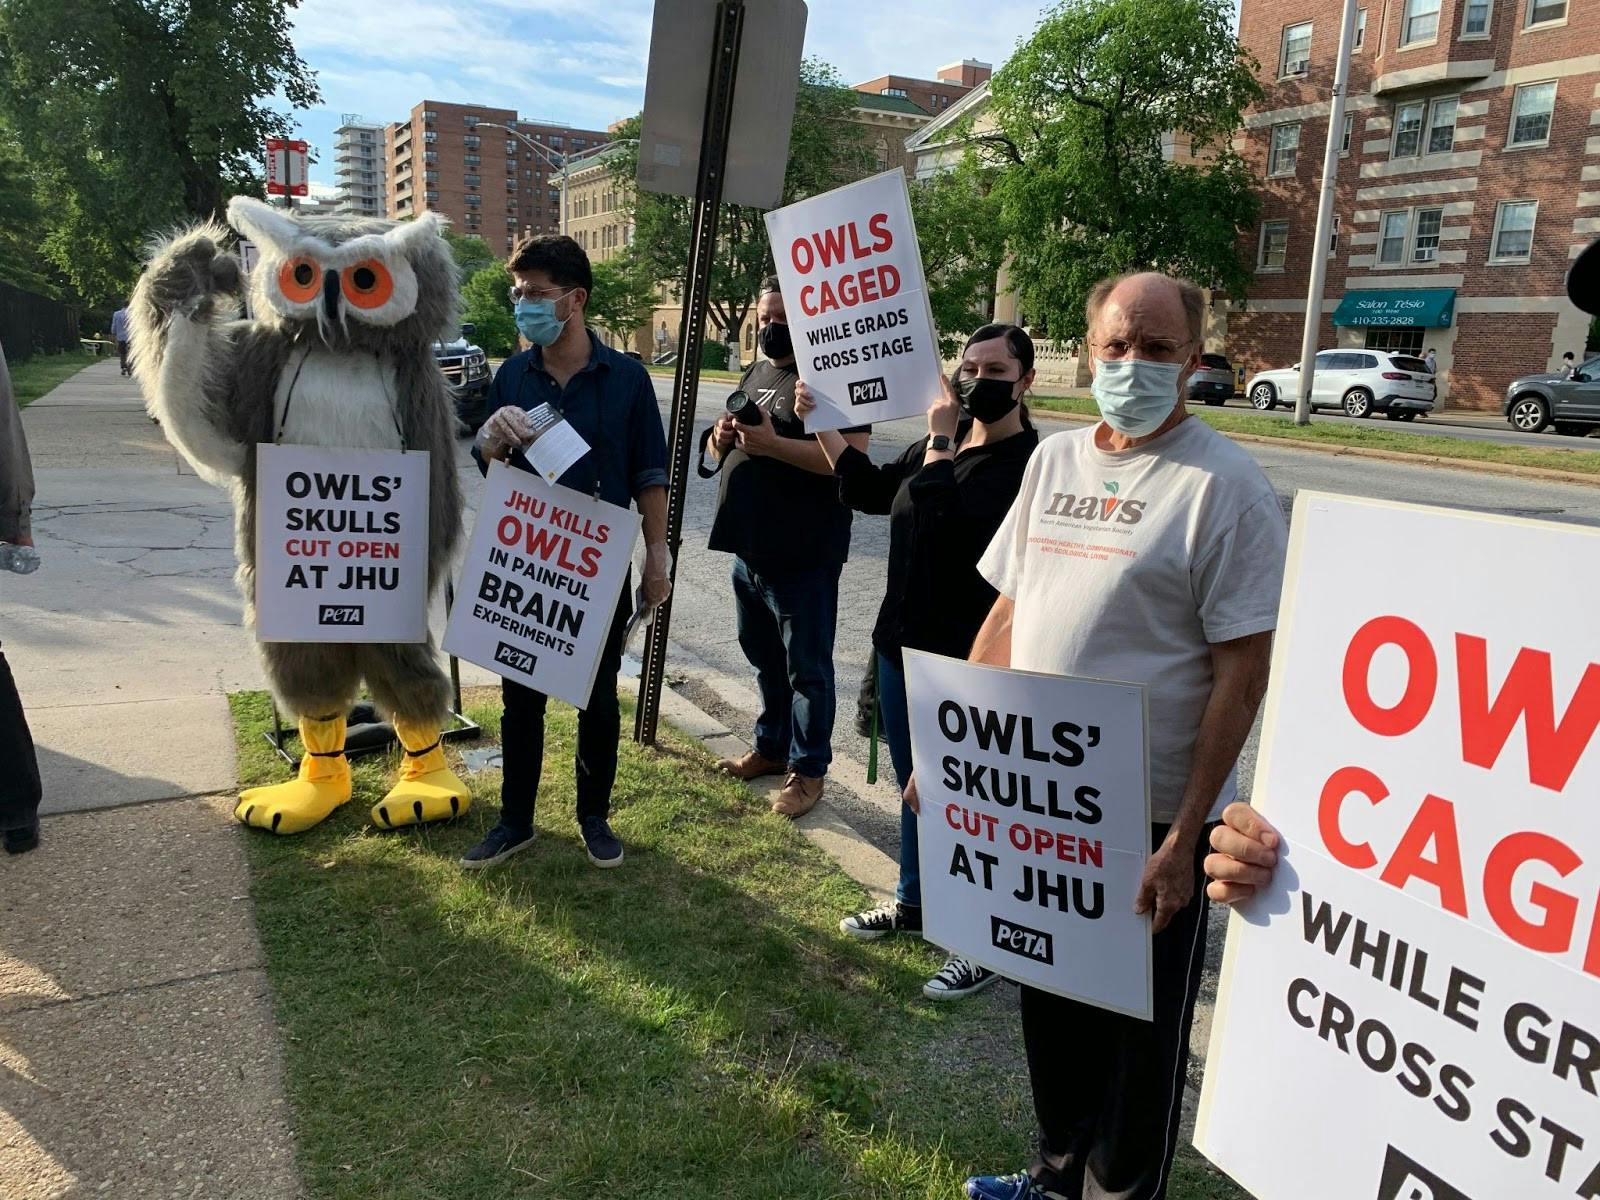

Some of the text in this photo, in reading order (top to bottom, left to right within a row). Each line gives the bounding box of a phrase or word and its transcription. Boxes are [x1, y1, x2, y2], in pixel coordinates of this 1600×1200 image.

[791, 213, 893, 275] OWLS
[800, 264, 901, 317] CAGED
[1356, 299, 1425, 308] Salon Tésio
[806, 308, 909, 346] WHILE GRADS
[1352, 316, 1414, 325] 410-235-2828
[813, 336, 914, 372] CROSS STAGE
[286, 508, 401, 534] SKULLS
[504, 490, 610, 544] JHU KILLS
[1044, 492, 1147, 525] navs
[1055, 520, 1081, 529] American
[1112, 527, 1134, 536] Society
[286, 539, 400, 559] CUT OPEN
[497, 515, 603, 578] OWLS
[285, 565, 399, 590] AT JHU
[488, 547, 591, 602] IN PAINFUL
[472, 603, 576, 657] EXPERIMENTS
[477, 571, 585, 639] BRAIN
[942, 755, 1103, 825] SKULLS
[945, 803, 1104, 868] CUT OPEN
[949, 844, 1105, 920] AT JHU
[1317, 766, 1600, 977] CAG
[1301, 890, 1487, 1033] WHILE
[1286, 977, 1600, 1200] CROSS ST
